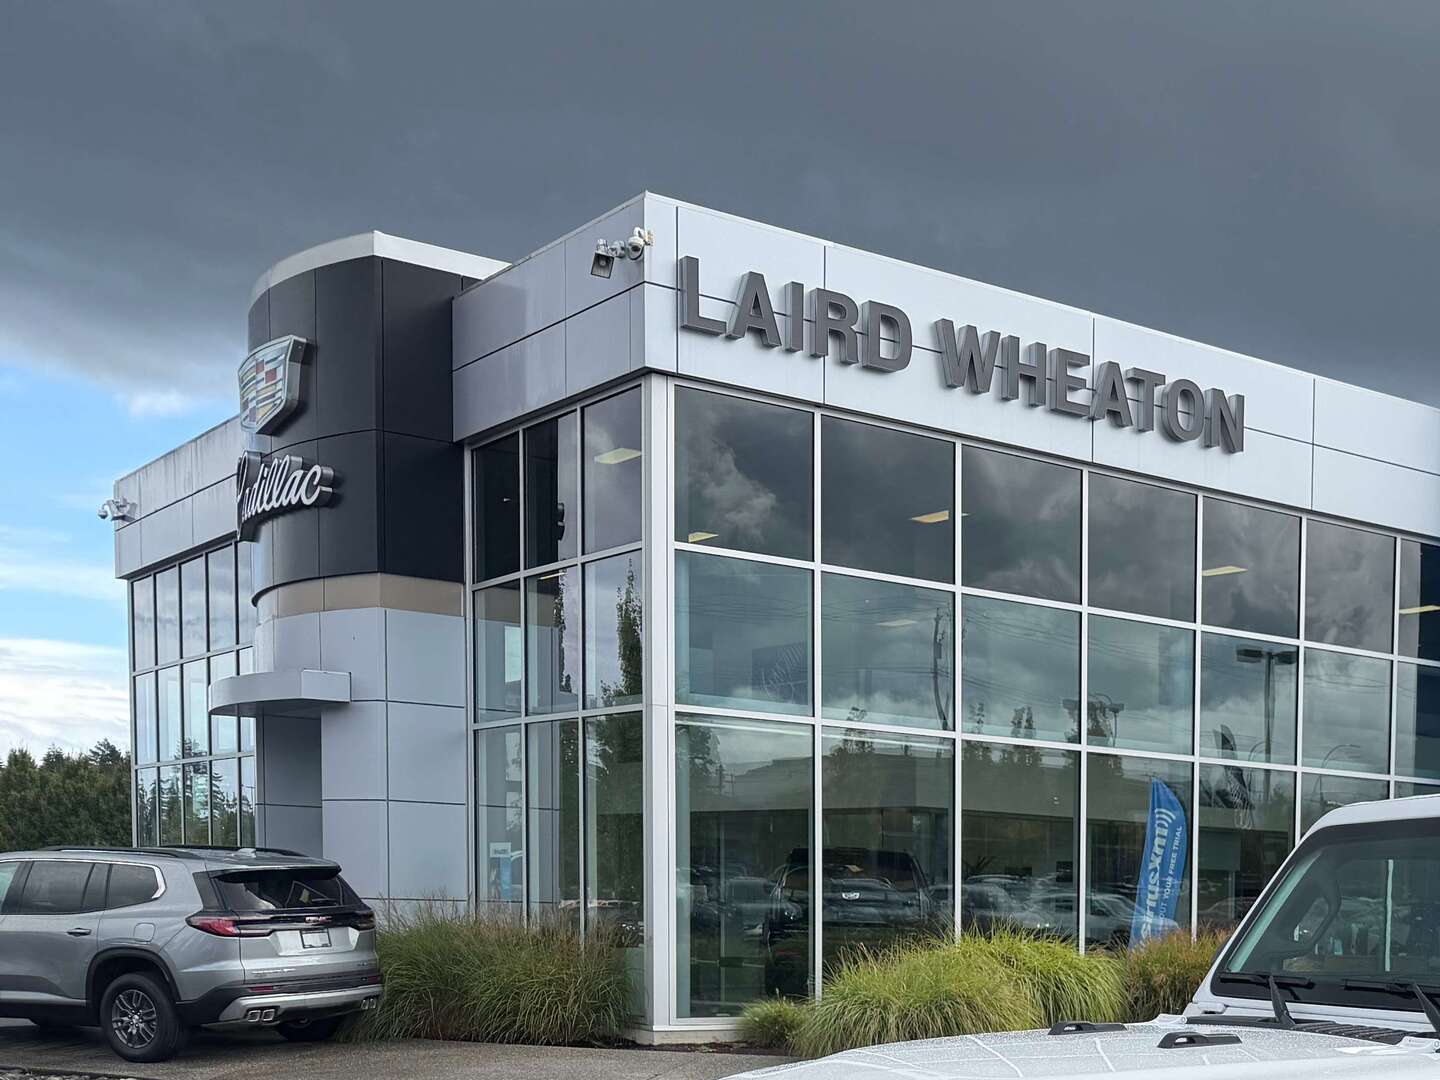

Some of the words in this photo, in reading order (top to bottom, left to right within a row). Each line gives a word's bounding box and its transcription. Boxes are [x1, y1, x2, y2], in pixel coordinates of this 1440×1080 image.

[679, 255, 913, 373] LAIRD
[934, 318, 1245, 454] WHEATON
[1172, 826, 1184, 851] TRIAL
